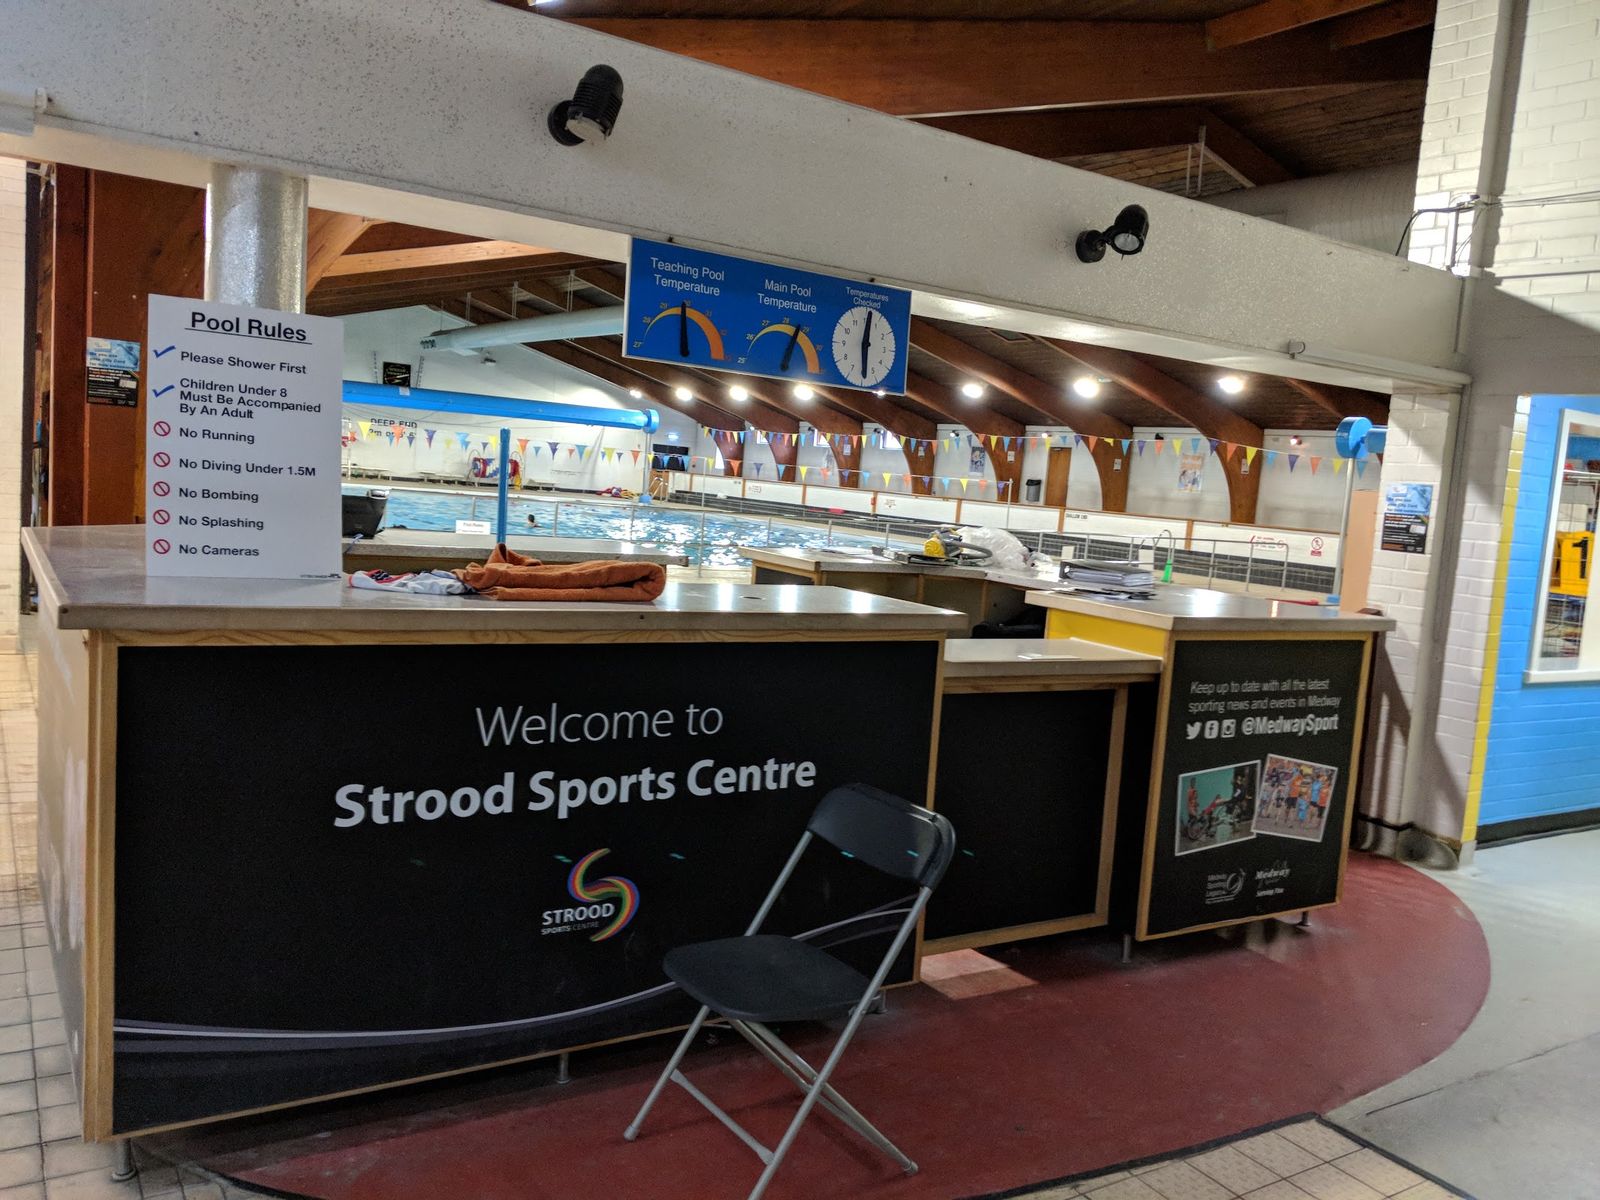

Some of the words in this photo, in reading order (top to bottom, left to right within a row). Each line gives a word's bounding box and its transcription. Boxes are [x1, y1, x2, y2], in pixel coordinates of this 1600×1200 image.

[650, 256, 699, 279] Teaching
[702, 266, 725, 281] Pool
[654, 273, 720, 296] Temperature
[764, 279, 788, 293] Main
[790, 283, 812, 297] Pool
[757, 292, 817, 313] Temperature
[846, 286, 889, 302] Temperatures
[853, 296, 881, 309] Checked
[191, 311, 240, 333] Pool
[247, 318, 307, 341] Rules
[180, 351, 224, 365] Please
[228, 356, 276, 371] Shower
[279, 362, 307, 374] First
[179, 378, 234, 392] Children
[238, 384, 277, 397] Under
[280, 388, 288, 398] 8
[179, 390, 213, 403] Must
[217, 394, 234, 405] Be
[237, 396, 321, 413] Accompanied
[179, 403, 196, 415] By
[200, 405, 217, 416] An
[221, 407, 254, 419] Adult
[370, 418, 395, 427] DEEP
[179, 427, 198, 438] No
[202, 429, 255, 445] Running
[179, 458, 198, 469] No
[202, 459, 242, 474] Diving
[245, 462, 283, 475] Under
[287, 466, 316, 476] 1.5M
[178, 487, 198, 498] No
[201, 489, 259, 503] Bombing
[178, 515, 198, 526] No
[201, 516, 264, 531] Splashing
[178, 544, 198, 555] No
[201, 545, 260, 557] Cameras
[1572, 536, 1589, 579] 1
[1190, 681, 1215, 695] Keep
[1216, 683, 1229, 695] up
[1230, 681, 1240, 693] to
[1241, 680, 1261, 693] date
[1261, 679, 1280, 692] with
[1281, 679, 1292, 691] all
[1292, 679, 1306, 691] the
[1307, 678, 1330, 690] latest
[1188, 699, 1225, 714] sporting
[1226, 700, 1250, 711] news
[1251, 697, 1269, 710] and
[1269, 697, 1297, 709] events
[1297, 696, 1306, 708] in
[1307, 695, 1342, 708] Medway
[475, 702, 674, 748] Welcome
[684, 703, 724, 736] to
[1241, 713, 1339, 736] @MedwaySport
[333, 771, 515, 829] Strood
[527, 767, 675, 820] Sports
[686, 757, 817, 798] Centre
[1255, 868, 1291, 880] Medway
[542, 902, 616, 926] STROOD
[541, 925, 572, 936] SPORTS
[572, 921, 600, 931] CENTRE
